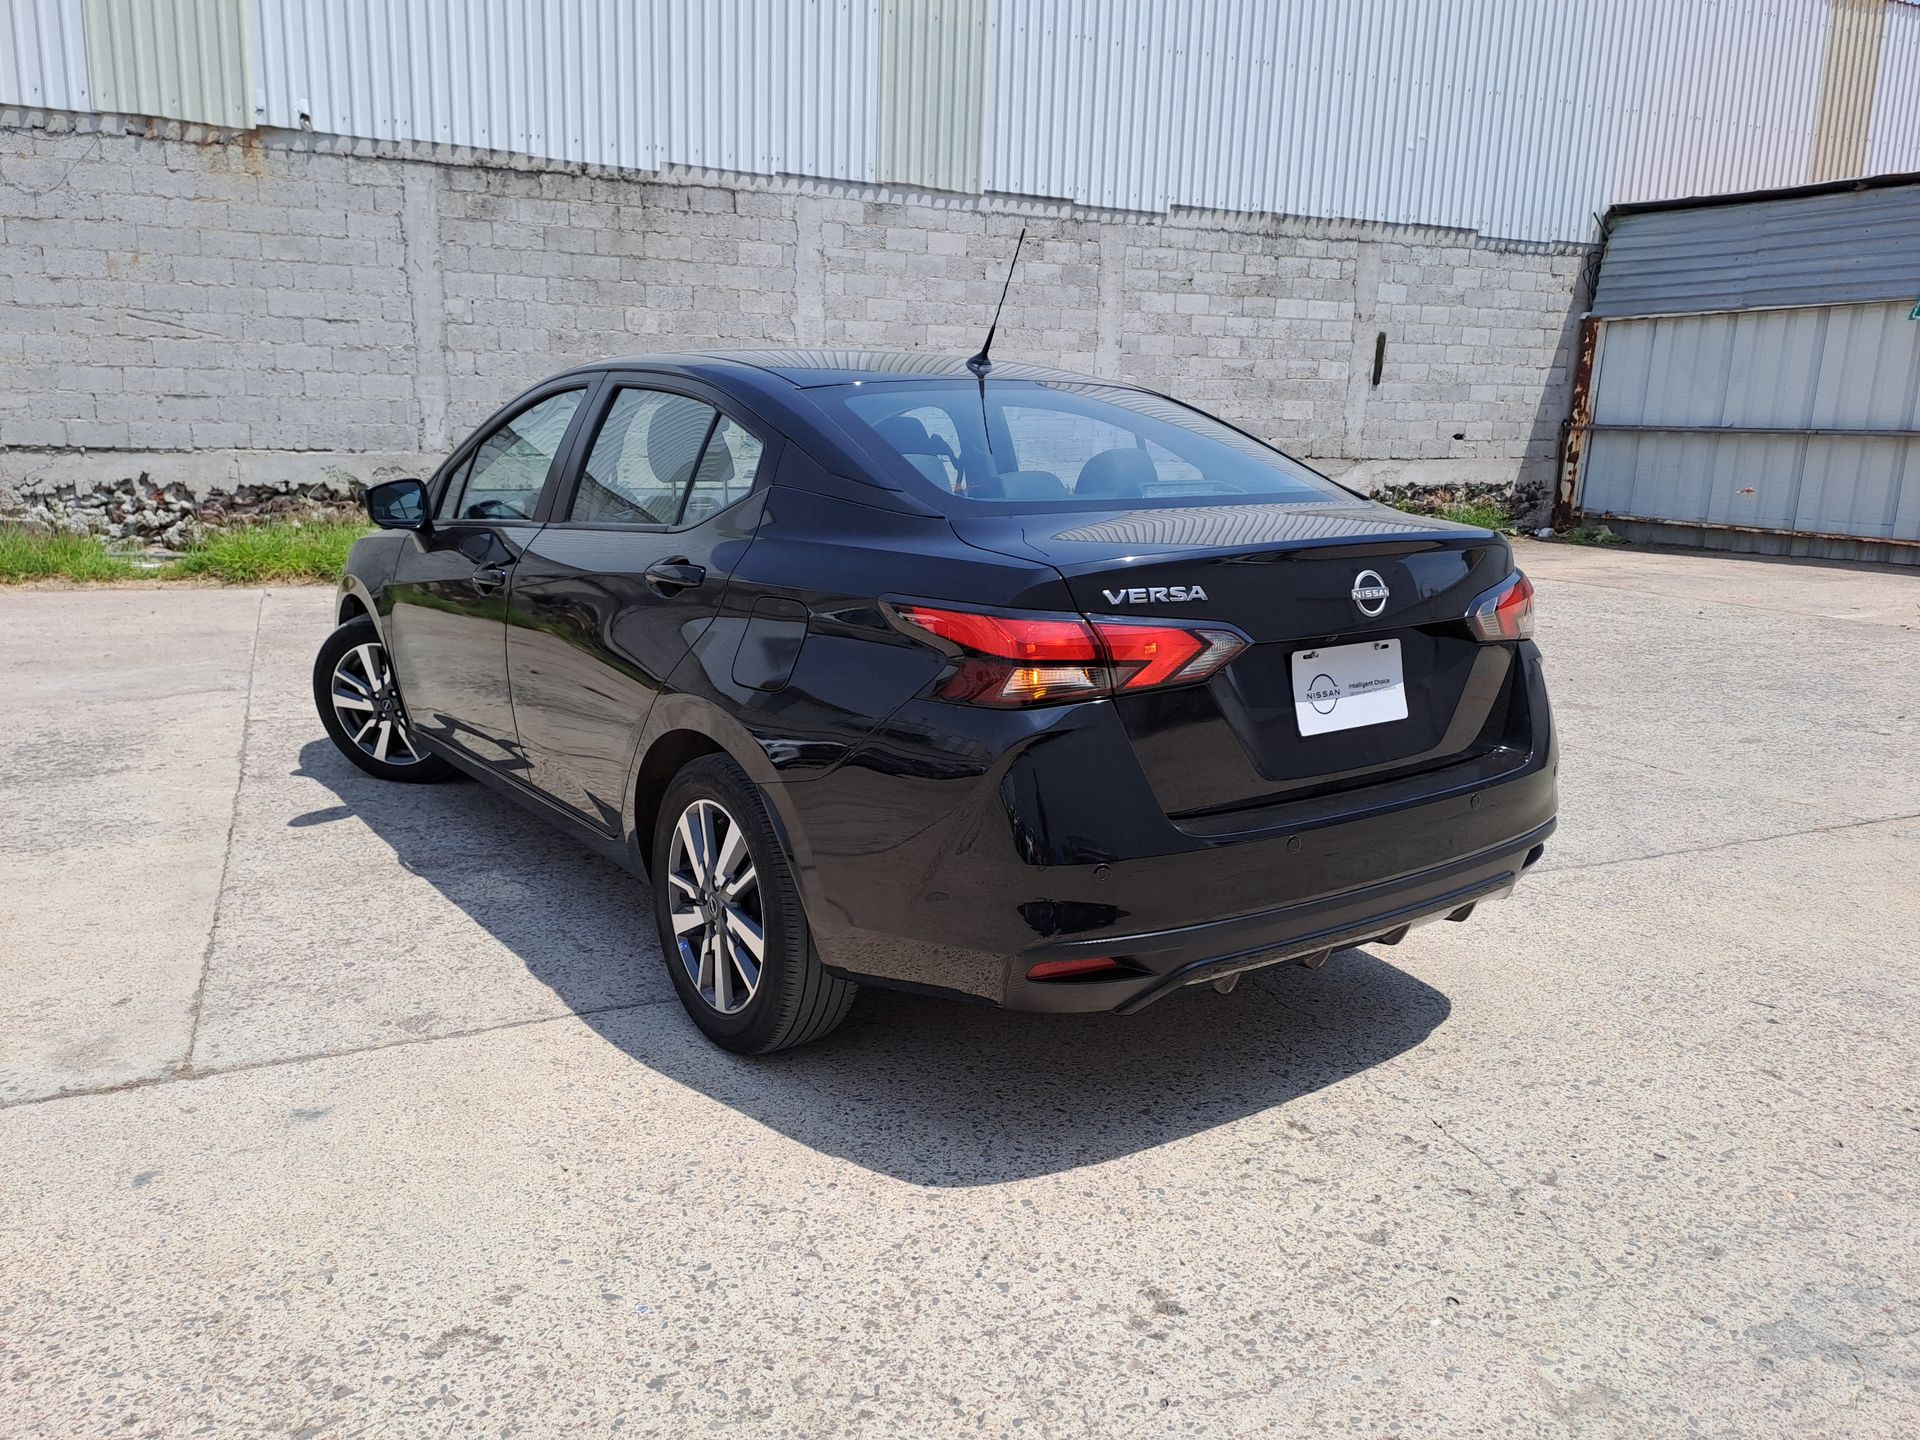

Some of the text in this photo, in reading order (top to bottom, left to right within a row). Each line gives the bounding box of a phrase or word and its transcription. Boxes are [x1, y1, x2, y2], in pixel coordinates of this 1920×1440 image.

[1102, 585, 1208, 605] VERSA
[1353, 588, 1389, 599] NISSAN
[1348, 681, 1373, 689] Intelligent
[1306, 689, 1340, 699] NISSAN
